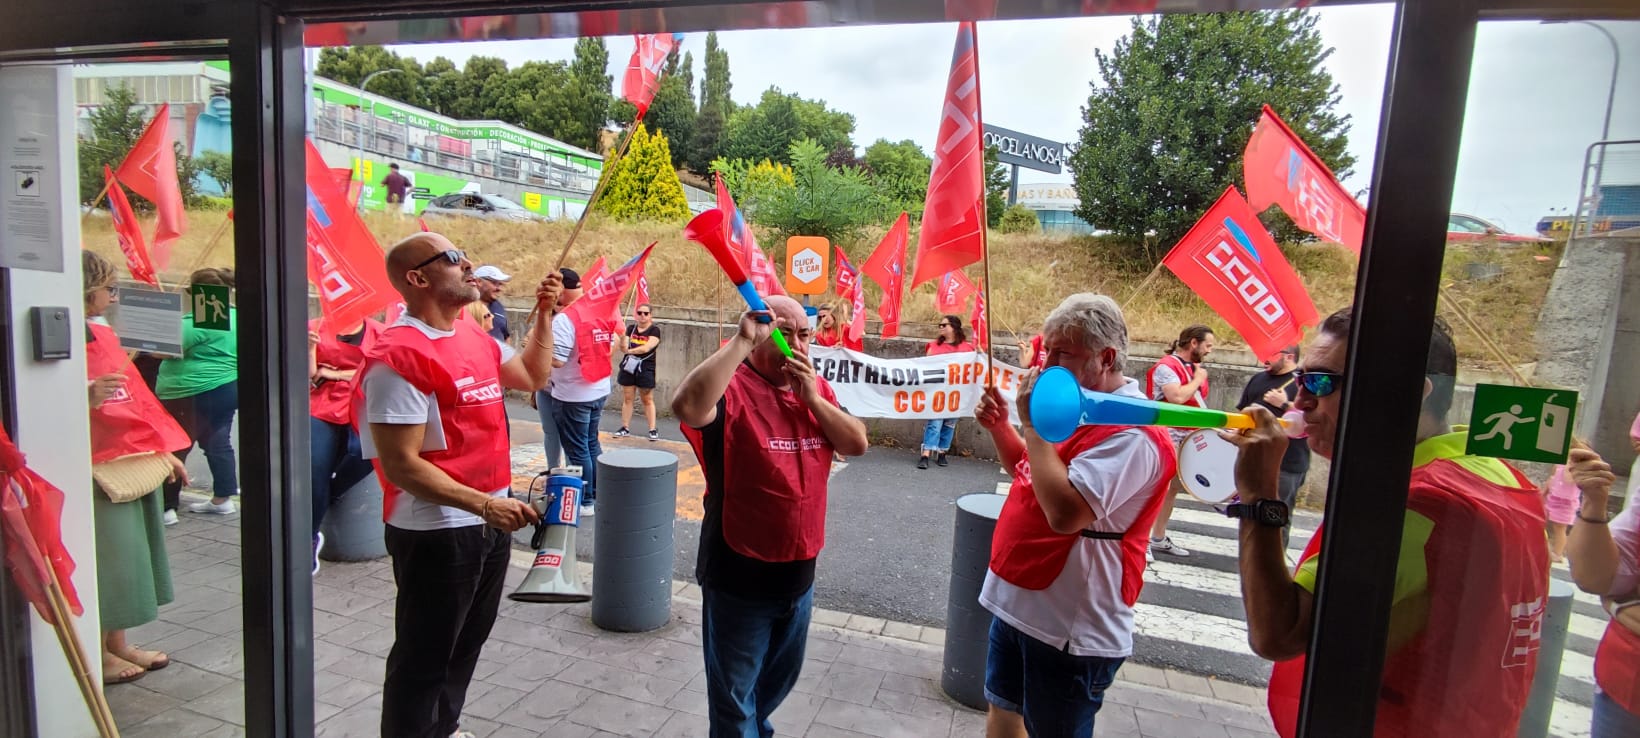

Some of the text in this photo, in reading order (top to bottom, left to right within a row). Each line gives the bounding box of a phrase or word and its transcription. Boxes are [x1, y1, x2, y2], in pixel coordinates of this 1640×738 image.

[982, 131, 1062, 166] ORCELANOSA
[794, 257, 815, 267] CLICK
[806, 263, 820, 273] CAR
[1205, 240, 1285, 325] CCOO
[812, 357, 920, 387] ECATHLON
[462, 383, 502, 402] CCOO
[769, 440, 800, 451] CCOO
[565, 490, 574, 519] CCOO
